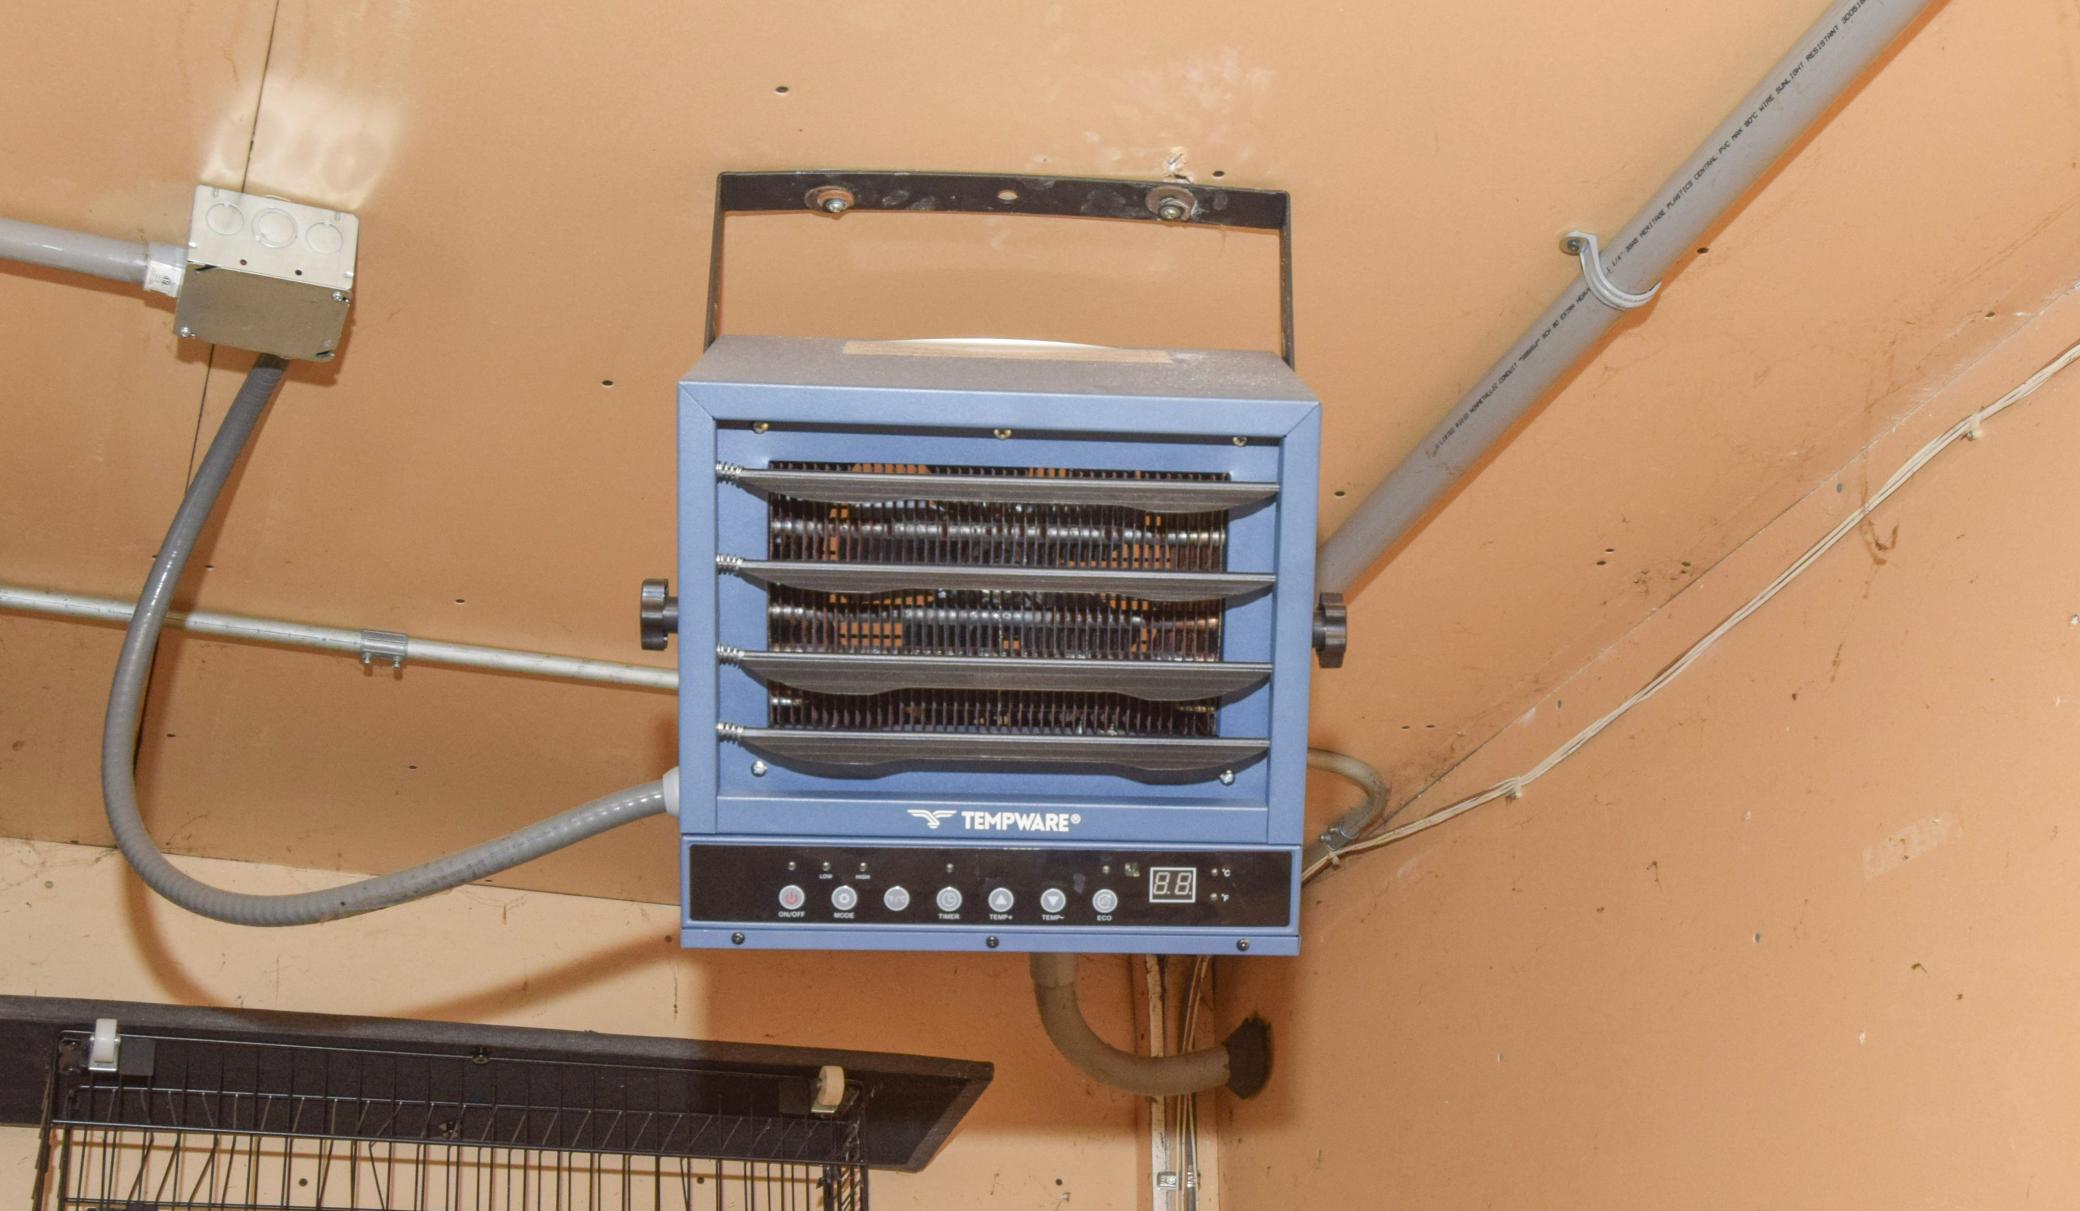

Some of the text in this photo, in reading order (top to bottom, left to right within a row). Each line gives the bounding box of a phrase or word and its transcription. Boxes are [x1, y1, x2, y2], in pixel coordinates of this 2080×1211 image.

[1499, 362, 1517, 384] CONDUIT
[1560, 304, 1575, 320] EXTRA
[1639, 209, 1666, 238] HERITAGE
[1666, 180, 1693, 209] PLASTICS
[1694, 156, 1718, 180] CENTRAL
[1718, 140, 1730, 154] PVC
[1731, 128, 1743, 141] MAX
[1759, 94, 1775, 112] WIRE
[1775, 62, 1804, 94] SUNLIGHT
[1805, 25, 1839, 62] RESISTANT
